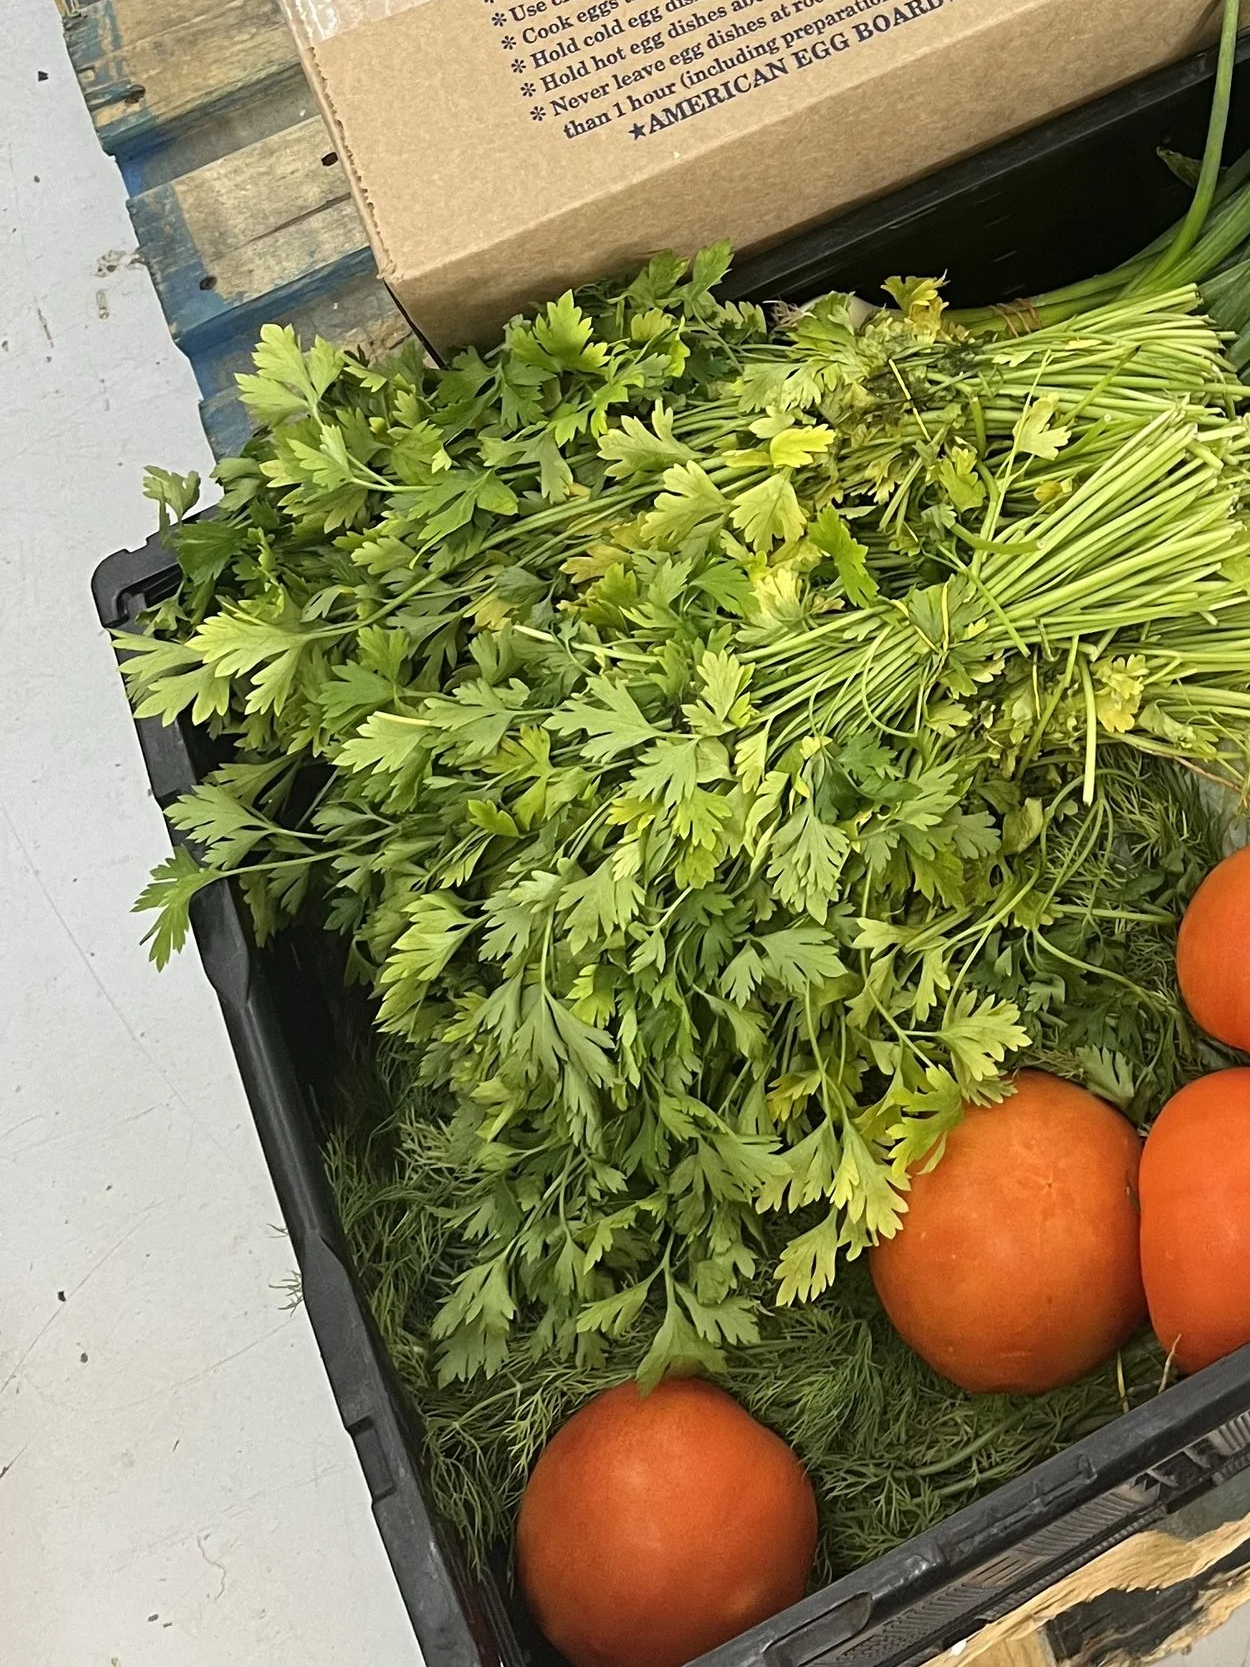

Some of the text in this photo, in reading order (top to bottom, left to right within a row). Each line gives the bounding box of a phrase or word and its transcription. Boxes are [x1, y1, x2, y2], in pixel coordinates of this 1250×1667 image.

[508, 1, 547, 21] Use
[523, 16, 574, 44] Cook
[530, 37, 581, 69] Hold
[583, 19, 625, 46] cold
[628, 6, 663, 28] egg
[540, 60, 591, 93] Hold
[590, 47, 626, 71] hot
[630, 32, 665, 54] egg
[668, 7, 727, 38] dishes
[549, 83, 609, 116] Never
[612, 60, 666, 90] leave
[669, 43, 704, 65] egg
[707, 17, 766, 49] dishes
[771, 4, 791, 22] at
[790, 32, 850, 69] EGG
[563, 113, 612, 139] than
[613, 102, 626, 118] 1
[626, 83, 676, 111] hour
[680, 38, 780, 89] (including
